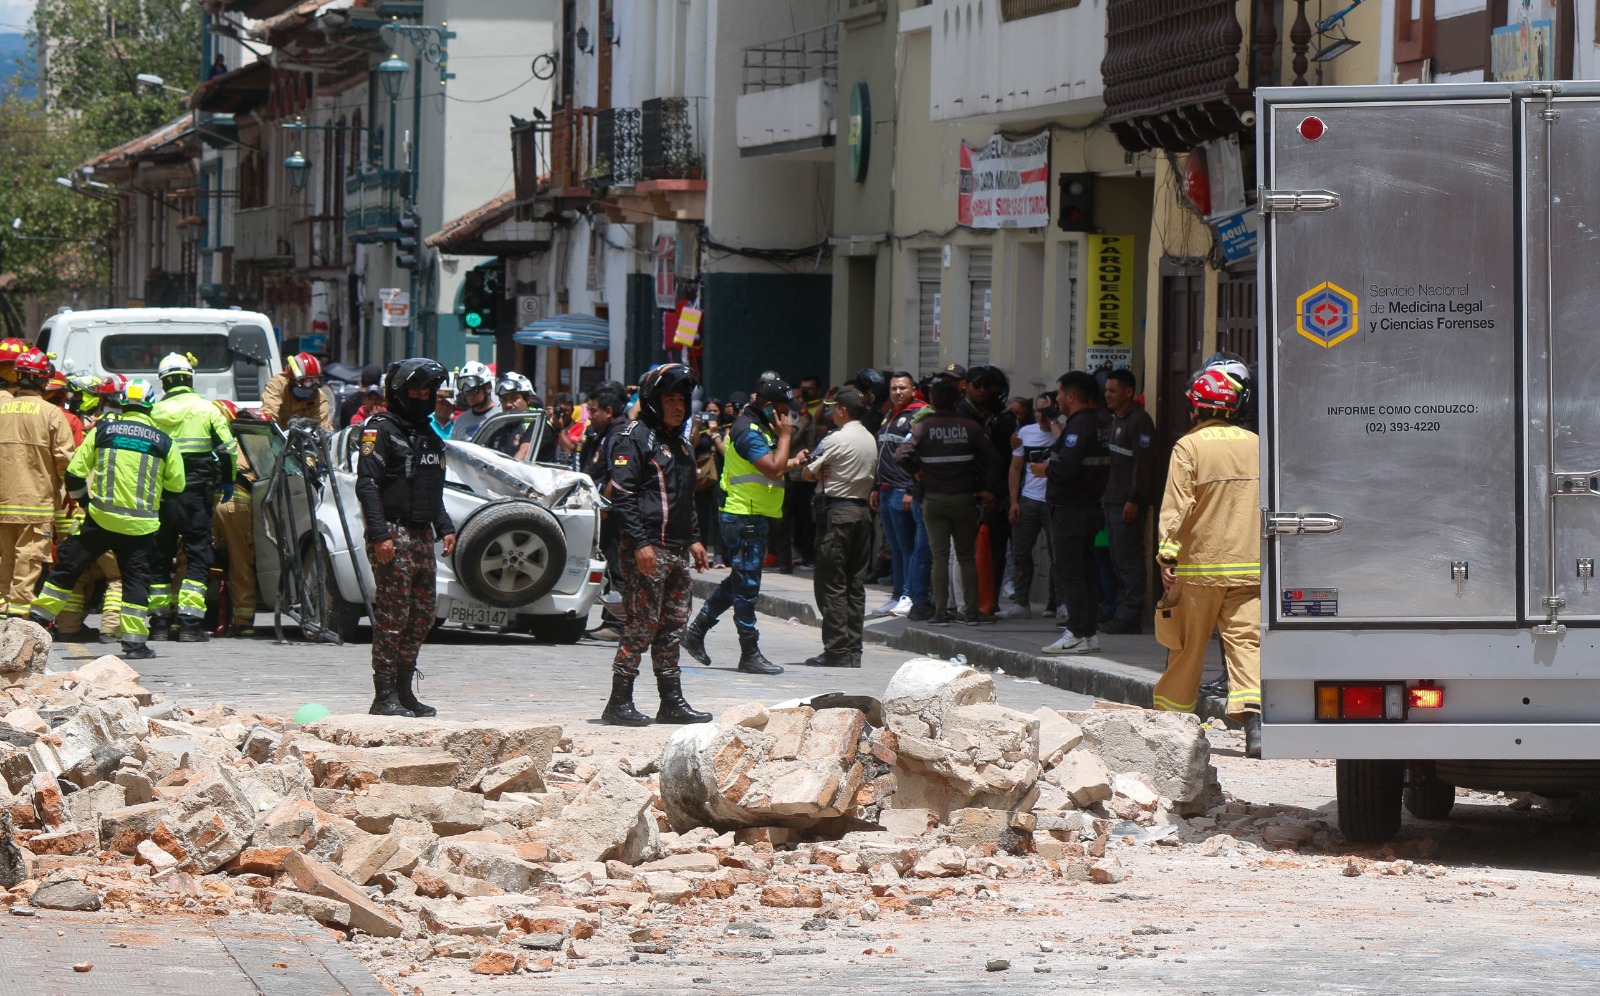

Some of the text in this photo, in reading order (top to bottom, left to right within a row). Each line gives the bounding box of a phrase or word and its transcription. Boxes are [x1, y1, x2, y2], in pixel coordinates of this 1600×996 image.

[1222, 222, 1246, 242] AQUÍ
[1098, 237, 1121, 339] PARQUEADERO
[1369, 283, 1469, 297] Servicio Nacional
[527, 301, 534, 310] E
[1369, 300, 1483, 315] de Medicina Legal
[1369, 317, 1495, 333] y Ciencias Forenses
[0, 400, 41, 415] CUENCA
[1327, 404, 1479, 416] INFORME COMO CONDUZCO:
[106, 424, 161, 444] EMERGENCIAS
[929, 424, 968, 440] POLICÍA
[1199, 425, 1249, 441] CUENCA
[1365, 421, 1441, 435] (02) 393-4220
[420, 453, 440, 465] ACM
[451, 607, 507, 624] PBH-3147
